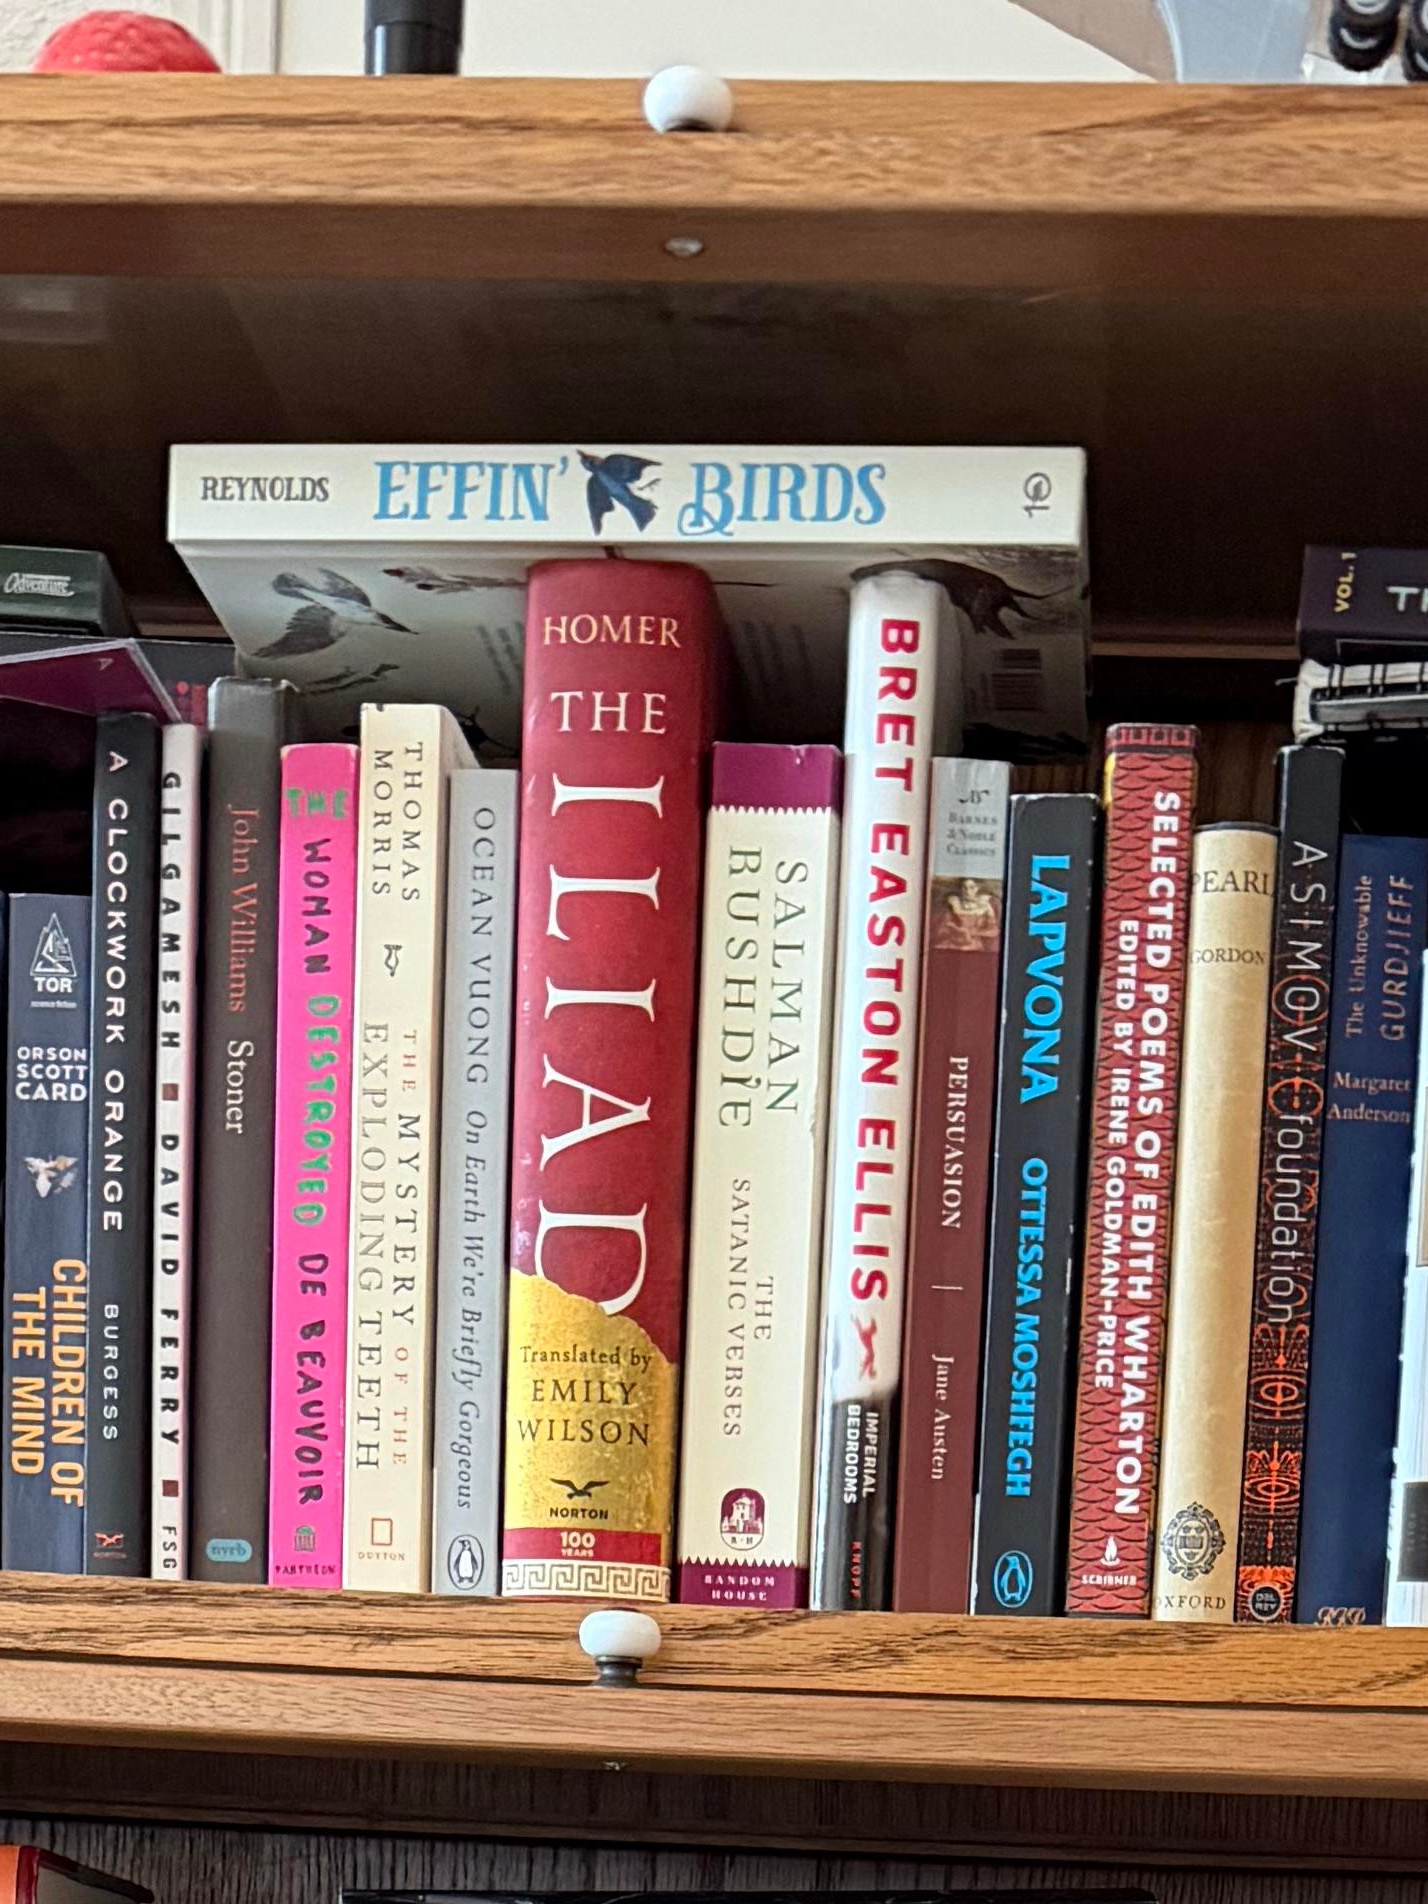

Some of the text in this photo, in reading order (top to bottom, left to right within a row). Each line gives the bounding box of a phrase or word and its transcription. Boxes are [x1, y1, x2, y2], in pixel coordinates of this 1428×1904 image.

[200, 475, 330, 503] REYNOLDS
[678, 461, 887, 534] BIRDS
[541, 614, 681, 648] HOMER
[552, 691, 667, 734] THE
[850, 617, 919, 1301] BRET EASTON ELLIS
[1019, 854, 1070, 1105] LAPVONA
[534, 774, 664, 1316] ILIAD
[530, 1376, 636, 1406] EMILY
[517, 1415, 651, 1445] WILSON
[549, 1506, 608, 1519] NORTON
